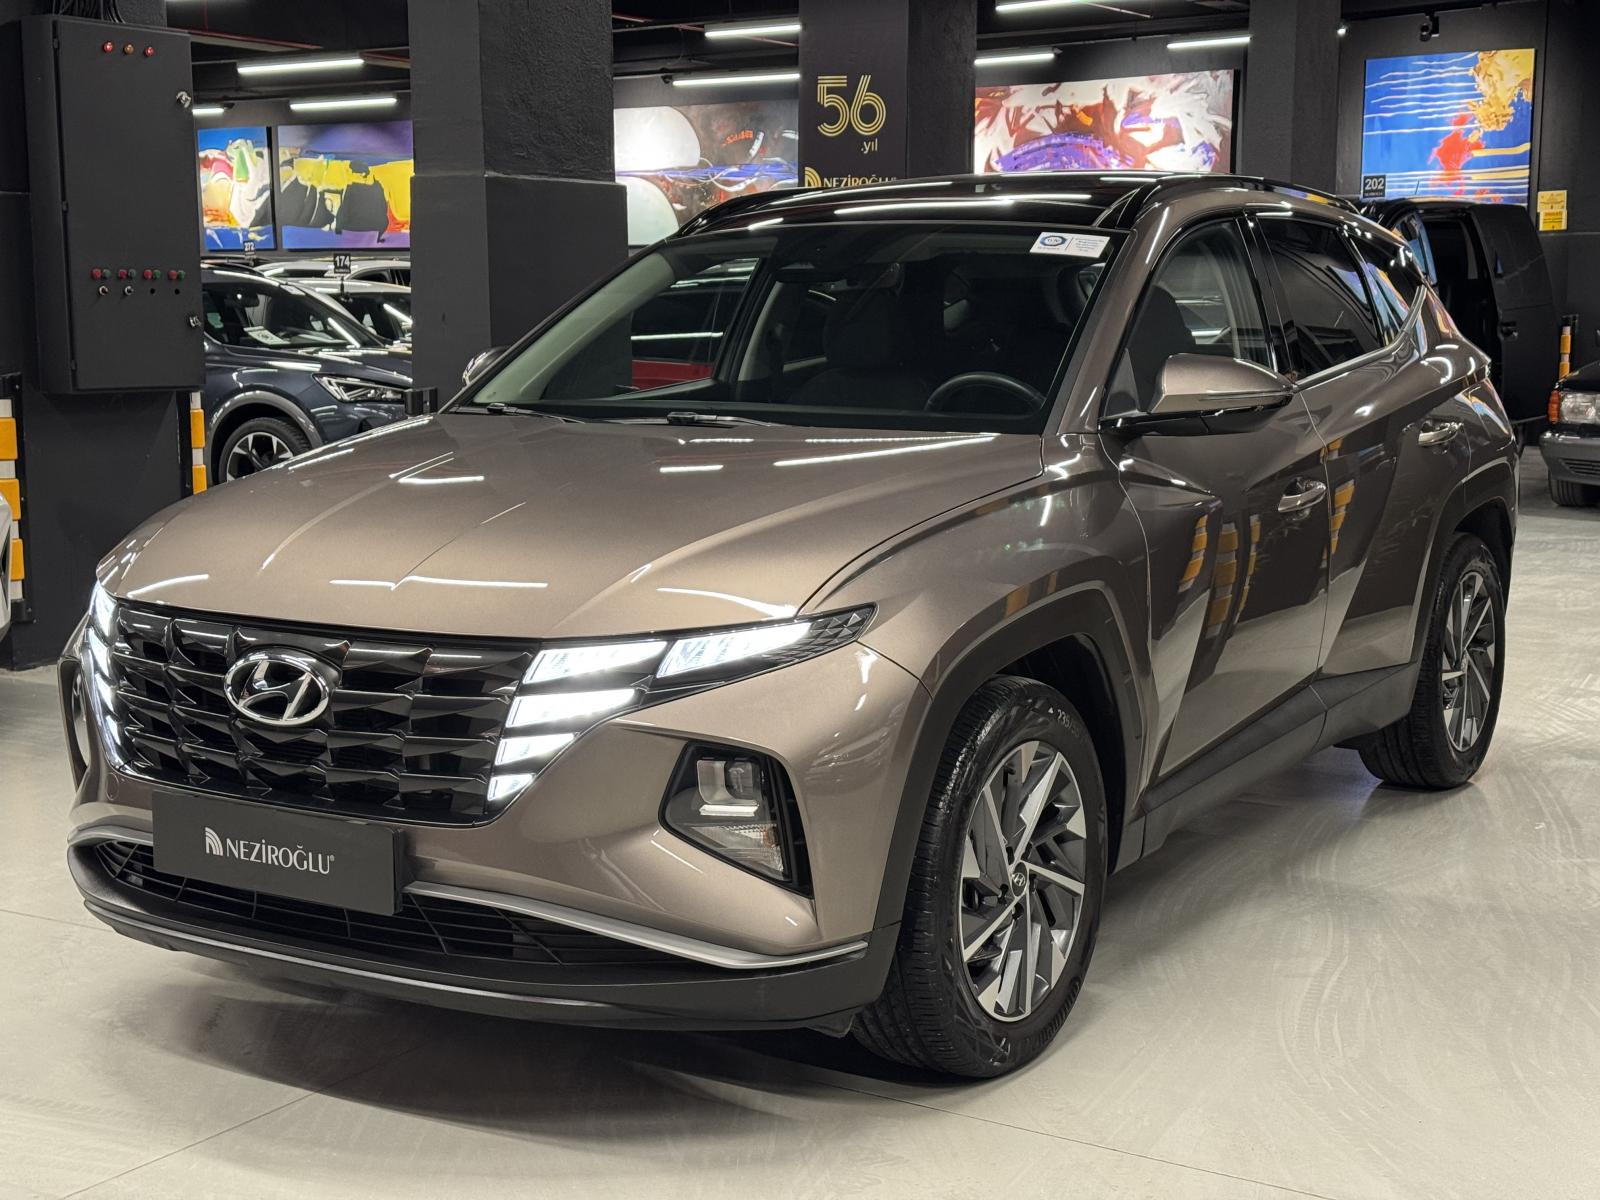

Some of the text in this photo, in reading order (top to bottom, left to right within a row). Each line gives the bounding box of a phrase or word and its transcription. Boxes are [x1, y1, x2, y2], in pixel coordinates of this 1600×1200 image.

[817, 75, 887, 137] 56
[1365, 178, 1385, 190] 202
[335, 255, 350, 267] 174
